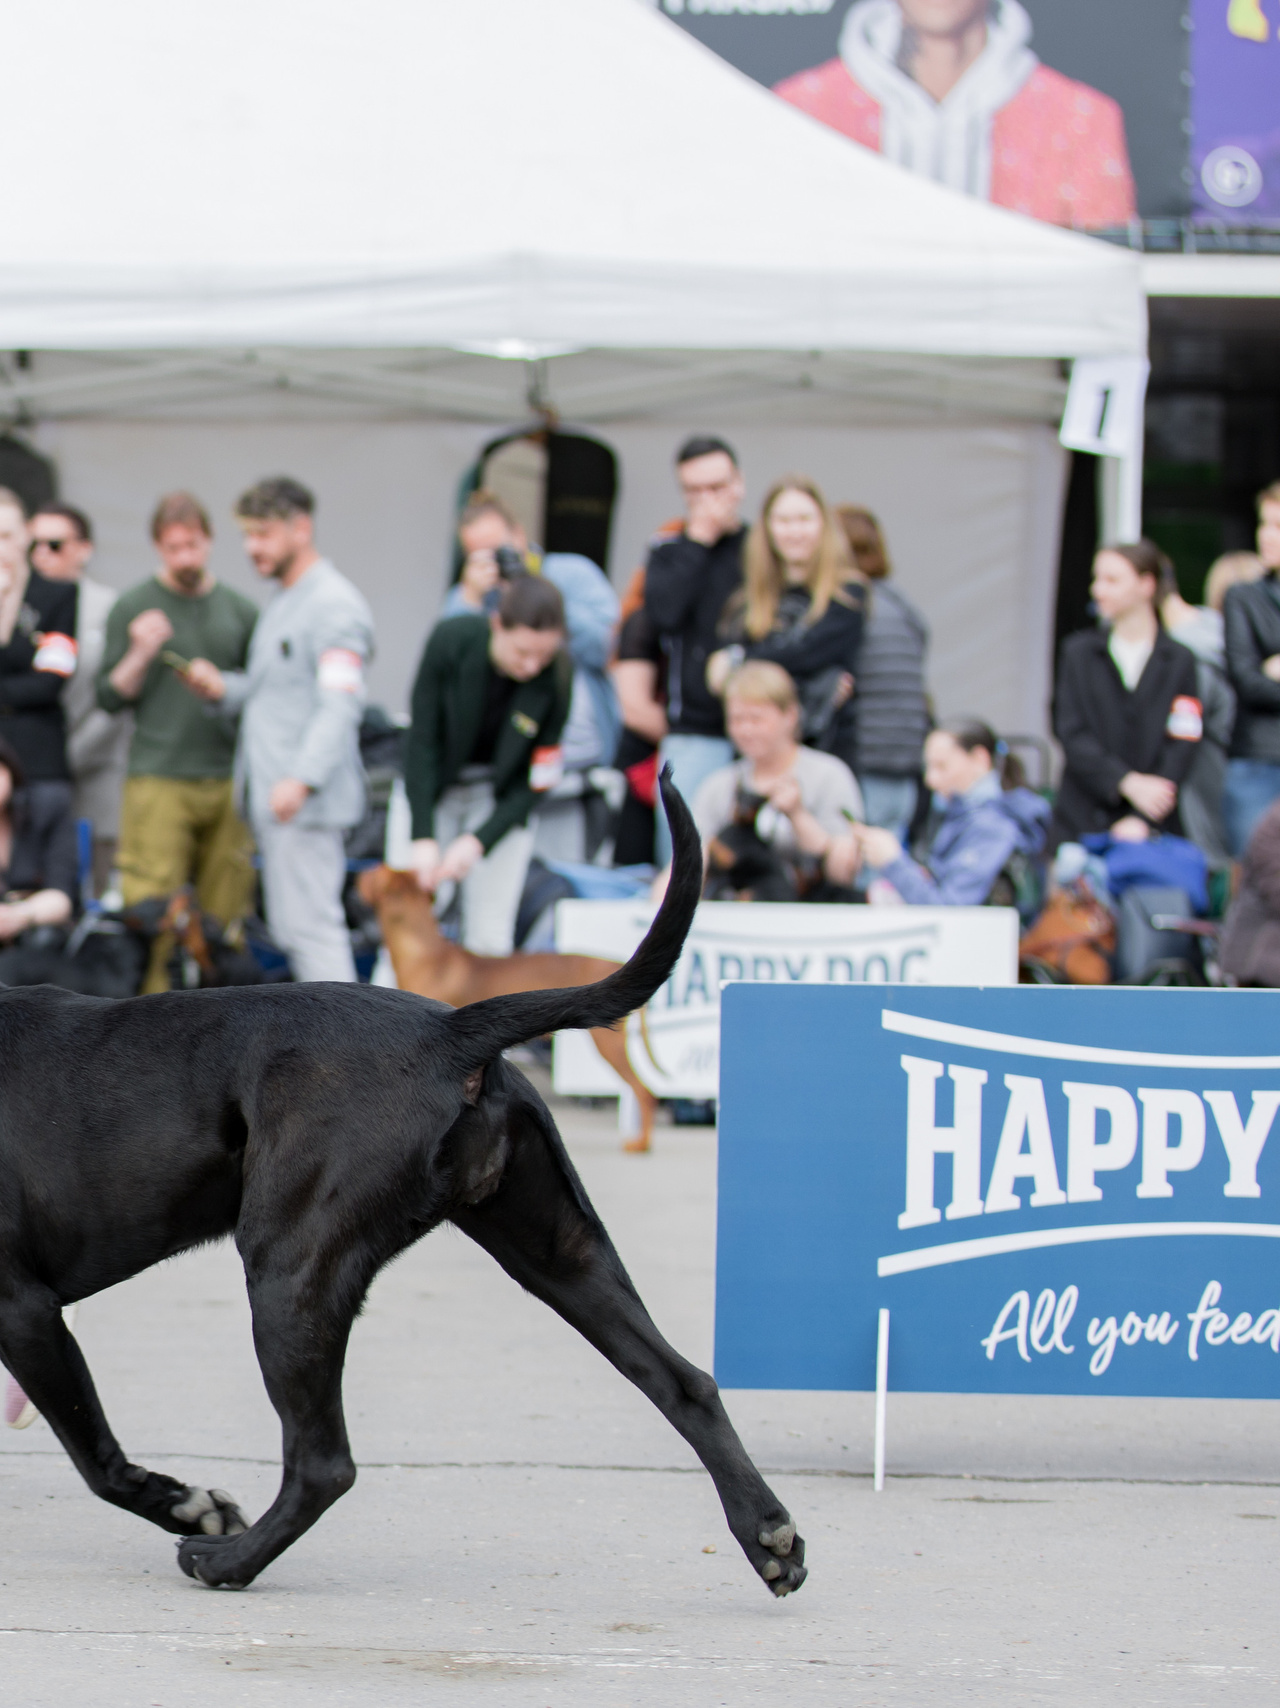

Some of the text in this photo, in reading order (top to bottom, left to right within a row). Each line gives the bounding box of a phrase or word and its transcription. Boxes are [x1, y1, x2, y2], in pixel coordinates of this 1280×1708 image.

[1095, 386, 1112, 439] 1
[898, 1054, 1280, 1230] HAPPY
[981, 1284, 1079, 1362] All
[1087, 1310, 1180, 1376] you
